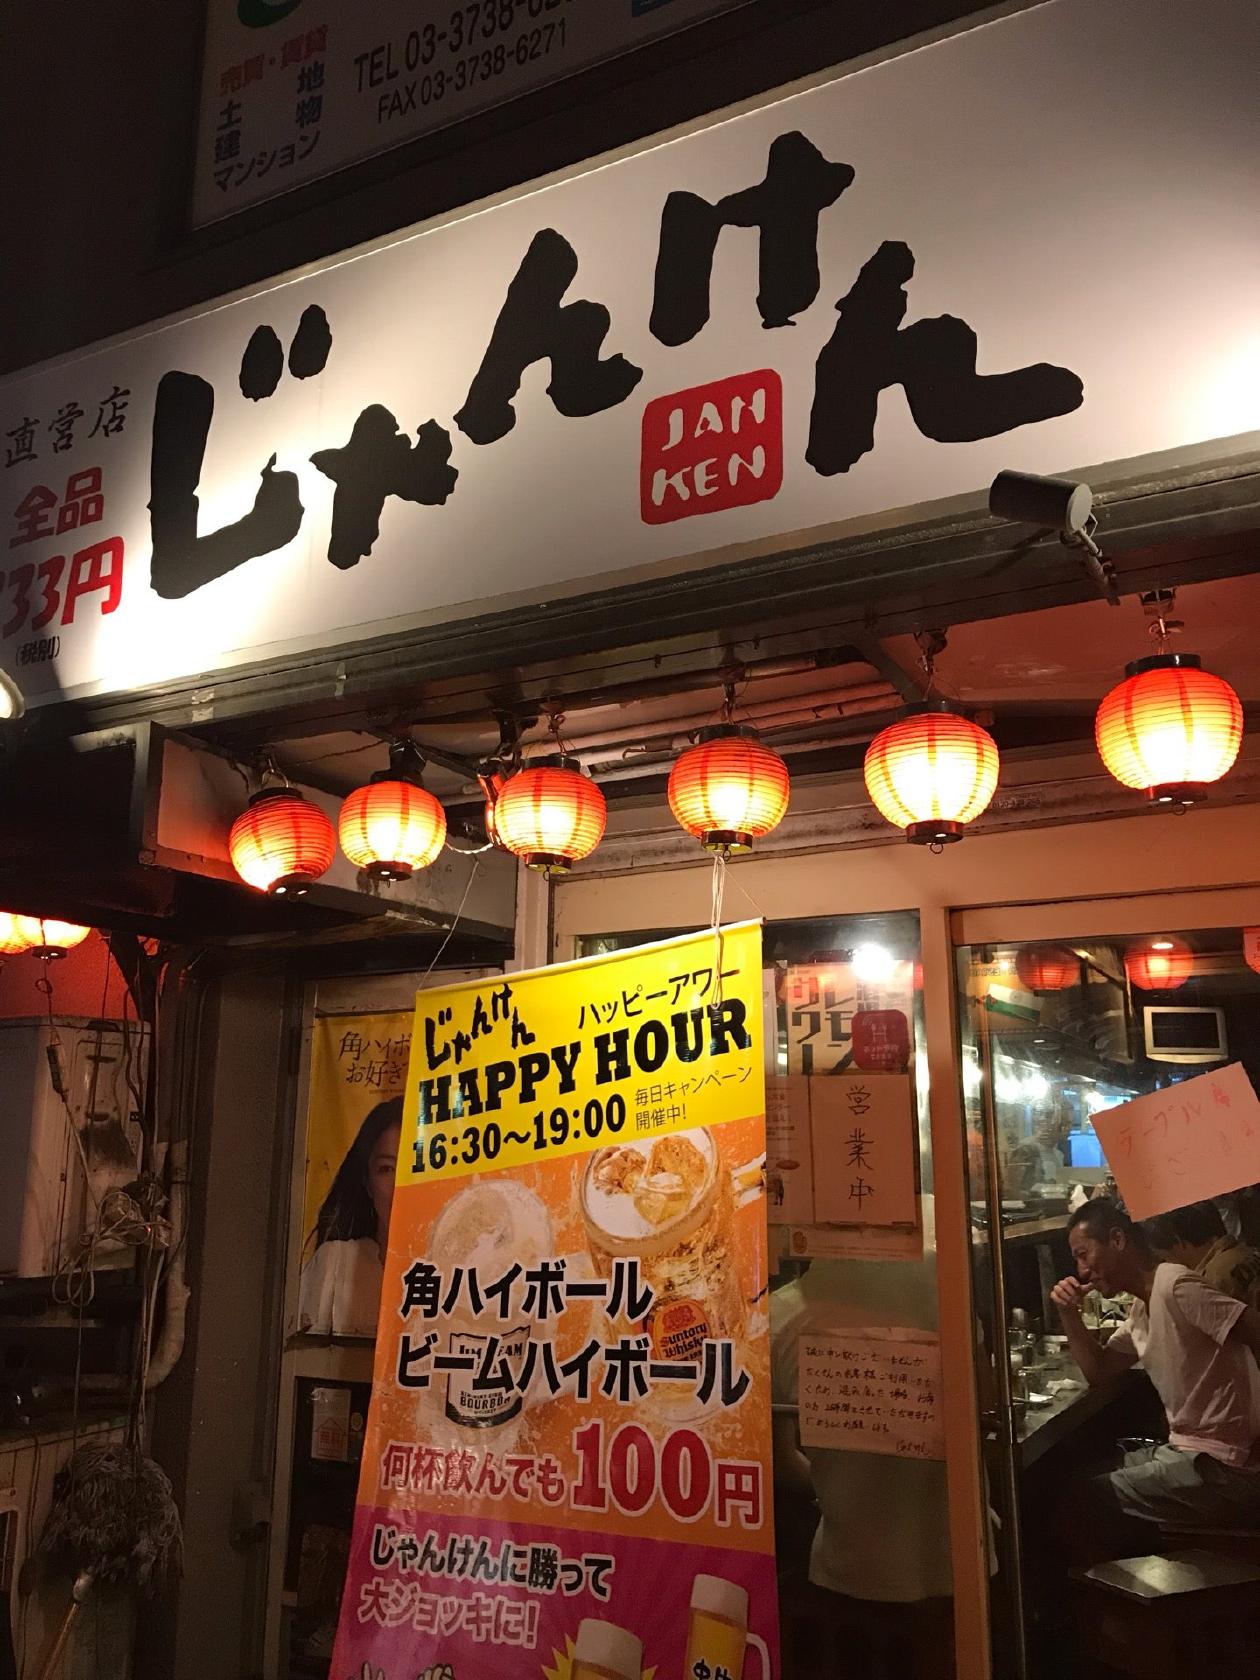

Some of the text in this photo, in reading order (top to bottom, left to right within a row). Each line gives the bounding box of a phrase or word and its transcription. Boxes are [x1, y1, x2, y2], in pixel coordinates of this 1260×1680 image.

[355, 0, 573, 92] TEL 03-3738-
[213, 130, 321, 193] マンション
[147, 130, 1084, 600] じゃんけん
[5, 386, 130, 468] 直営店
[662, 388, 766, 451] JAN
[9, 466, 104, 549] 全品
[652, 445, 766, 506] KEN
[0, 536, 125, 640] 33円
[425, 983, 536, 1071] じゃんけん
[578, 967, 740, 1030] ハッピーアワー
[346, 1060, 409, 1087] お好き
[418, 997, 752, 1125] HAPPY HOUR
[635, 1066, 752, 1107] 毎日キャンペーン
[844, 1084, 875, 1211] 営業中
[400, 1261, 653, 1321] 角ハイボール
[398, 1334, 750, 1406] ビームハイボール
[382, 1423, 762, 1526] 何杯飲んでも 100円
[373, 1528, 613, 1599] じゃんけんに勝って
